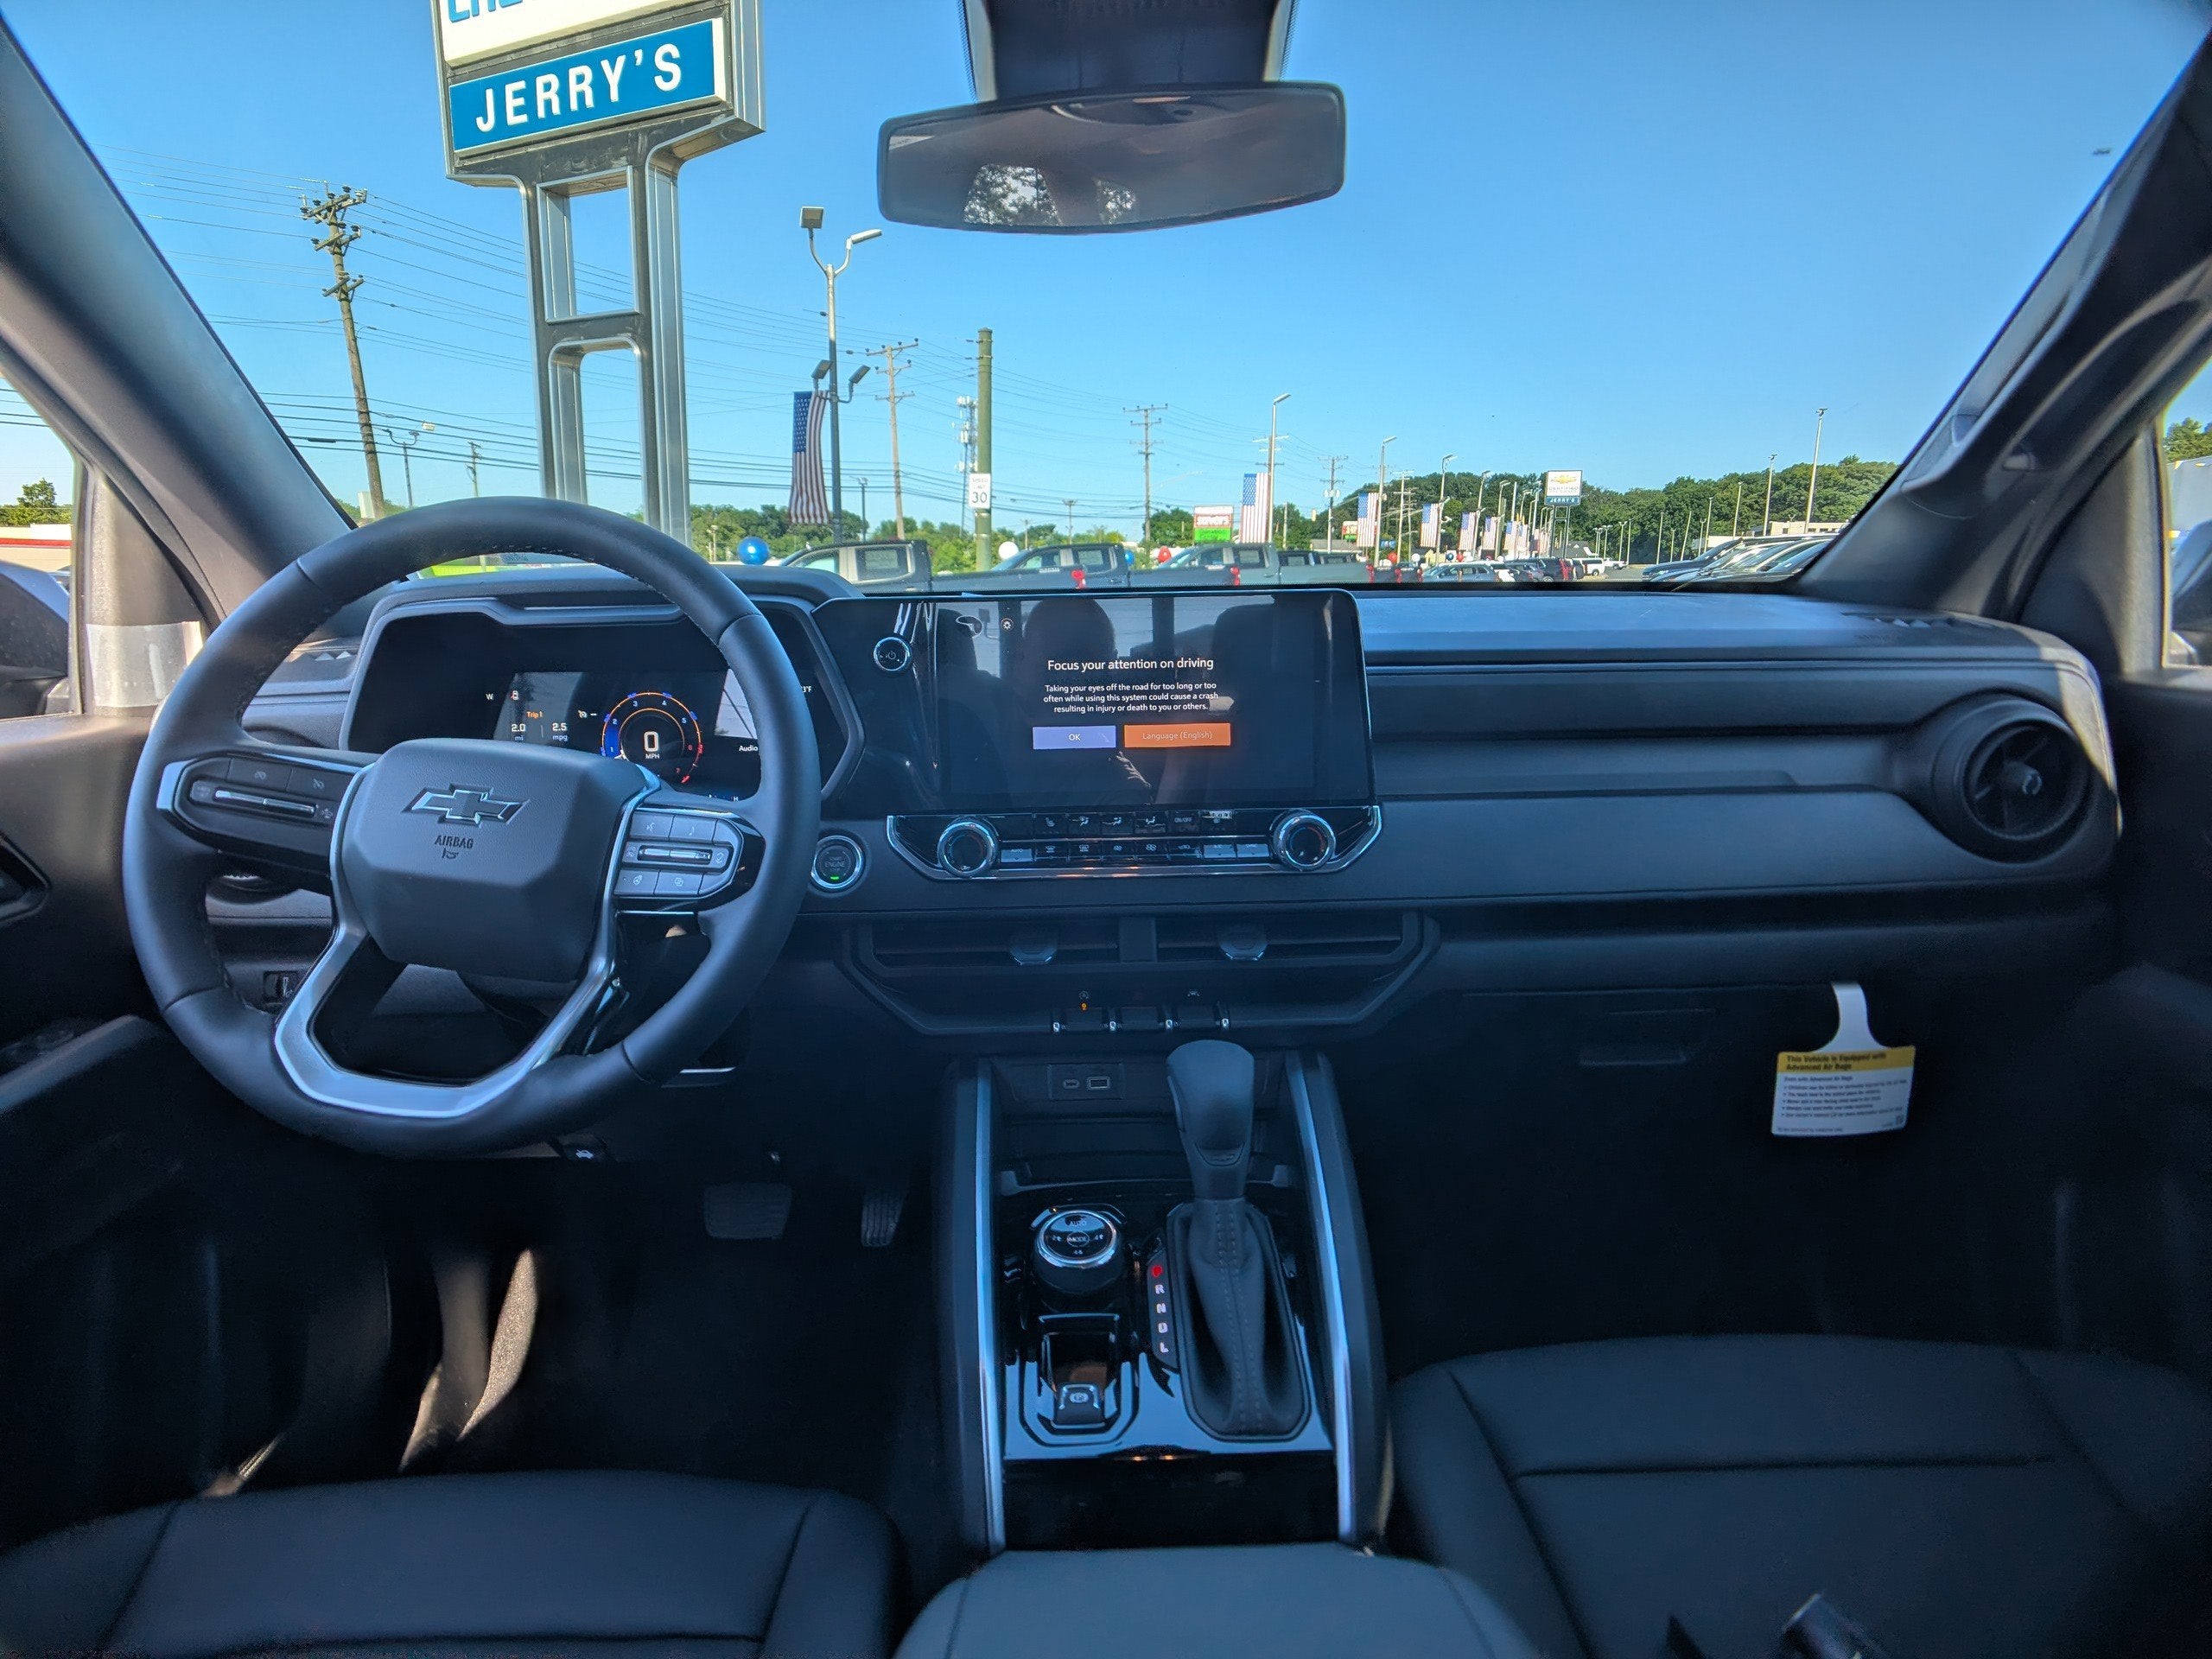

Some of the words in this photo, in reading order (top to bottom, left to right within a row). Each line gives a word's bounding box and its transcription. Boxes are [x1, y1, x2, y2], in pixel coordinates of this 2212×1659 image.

[475, 43, 682, 132] JERRY'S
[971, 492, 988, 504] 30
[1047, 660, 1079, 671] Focus
[1081, 661, 1106, 672] your
[1109, 659, 1157, 670] attention
[1177, 658, 1214, 671] driving
[1045, 685, 1069, 694] Taking
[1176, 683, 1193, 692] long
[1085, 695, 1105, 703] using
[1122, 694, 1147, 702] system
[1148, 692, 1169, 701] could
[1198, 691, 1219, 700] crash
[1053, 704, 1086, 714] resulting
[1095, 704, 1116, 714] injury
[512, 723, 525, 733] 2.0
[552, 722, 567, 732] 2.5
[1142, 732, 1179, 741] Language
[1179, 730, 1212, 741] (English)
[643, 732, 659, 753] 0
[434, 835, 474, 849] AIRBAG
[1155, 1284, 1165, 1294] R
[1156, 1303, 1166, 1313] N
[1158, 1322, 1168, 1333] D
[1160, 1342, 1169, 1353] L
